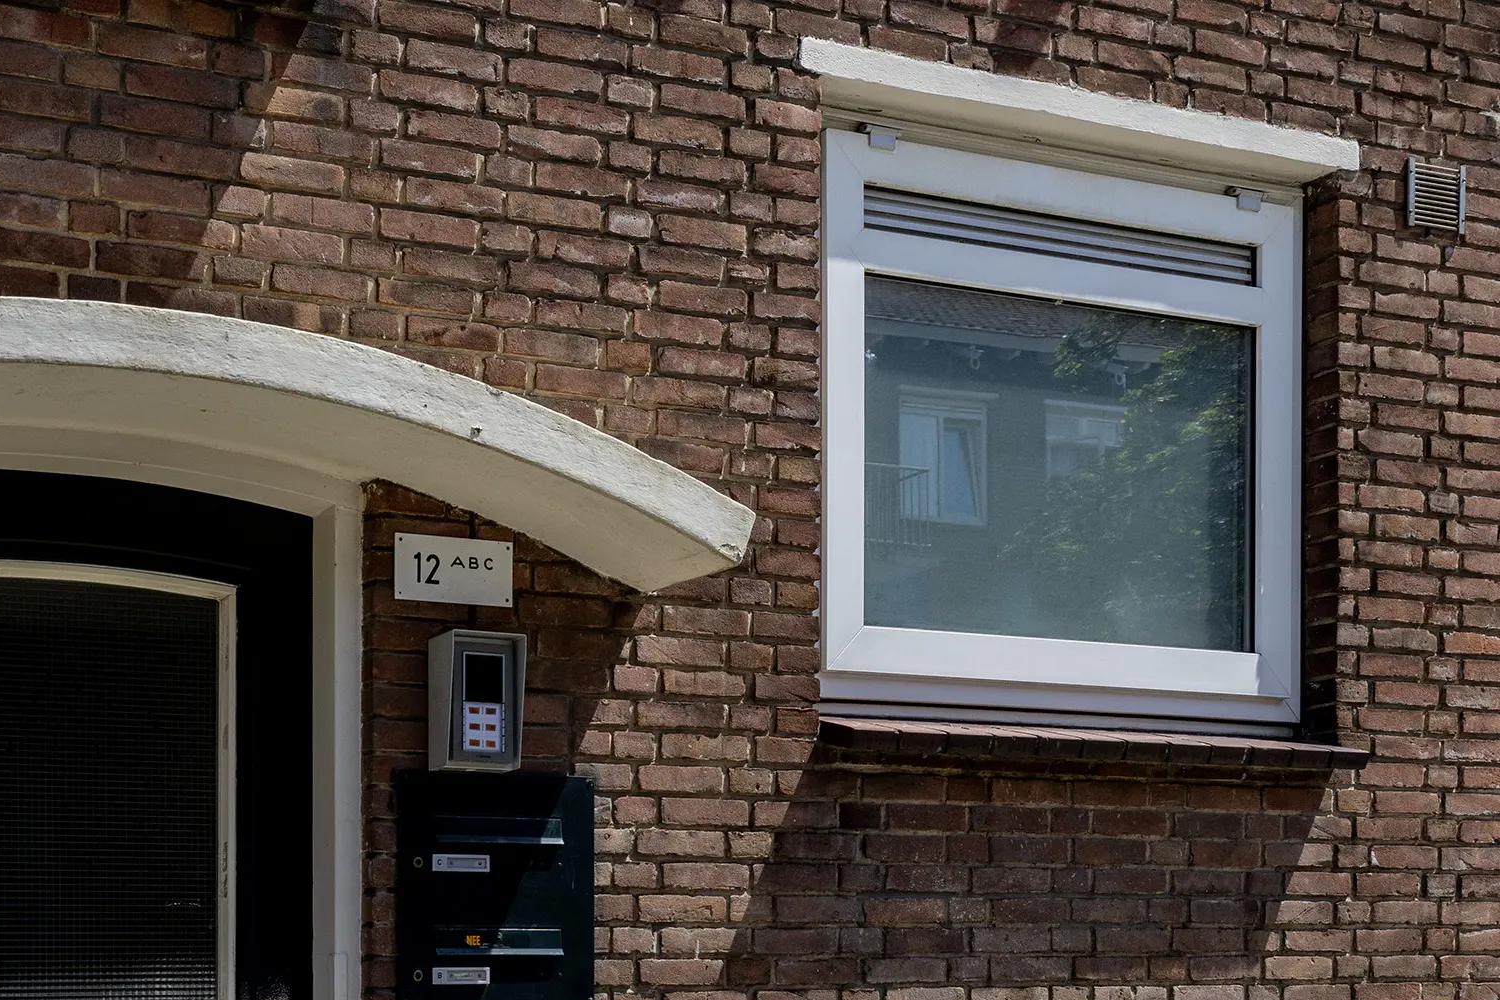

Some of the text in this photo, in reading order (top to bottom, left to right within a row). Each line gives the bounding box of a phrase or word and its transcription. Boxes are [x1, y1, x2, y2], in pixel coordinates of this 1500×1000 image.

[413, 551, 441, 585] 12
[437, 858, 442, 866] C
[466, 935, 481, 946] NEE
